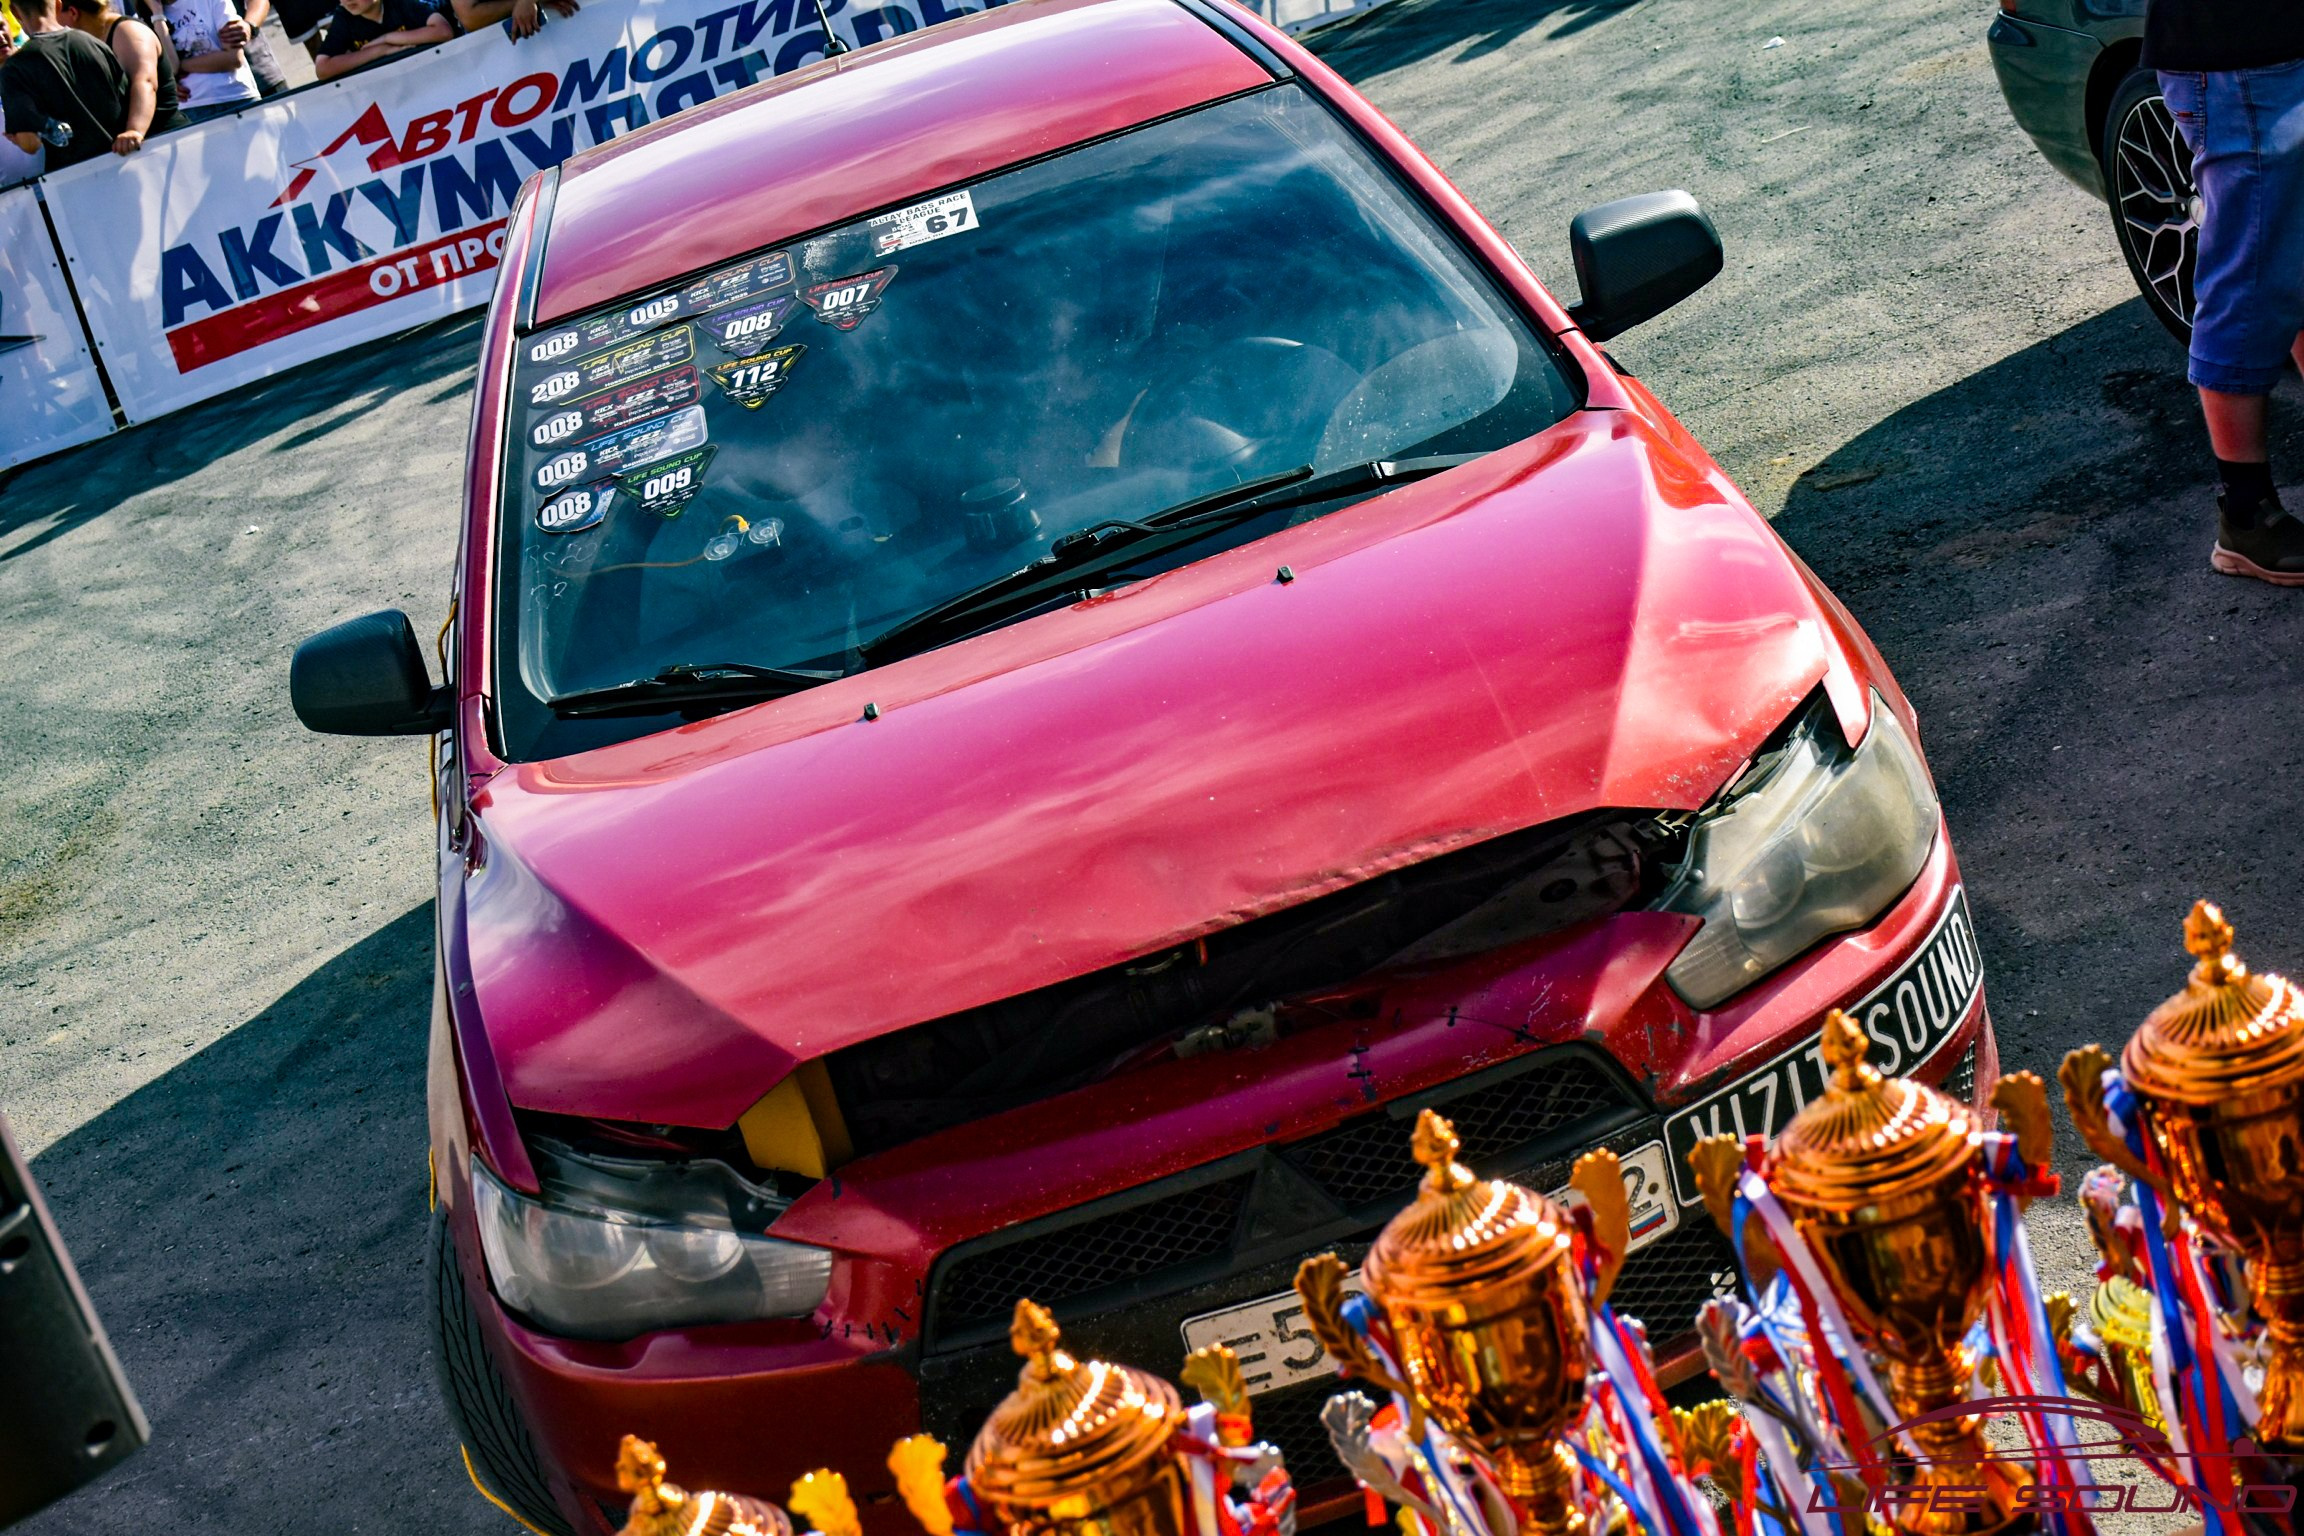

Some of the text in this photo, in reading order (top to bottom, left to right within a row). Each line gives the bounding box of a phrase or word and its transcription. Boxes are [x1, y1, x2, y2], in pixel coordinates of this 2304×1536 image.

[899, 206, 941, 224] LEAGUE
[906, 202, 935, 216] BASS
[938, 192, 967, 206] RACE
[925, 206, 968, 234] 67
[369, 256, 419, 297] ОТ
[864, 270, 885, 280] CUP
[630, 295, 680, 326] 005
[822, 283, 870, 311] 007
[724, 311, 773, 340] 008
[531, 331, 579, 363] 008
[582, 356, 610, 371] LIFE
[613, 340, 656, 359] SOUND
[659, 327, 688, 343] CUP
[717, 361, 738, 372] LIFE
[740, 353, 772, 365] SOUND
[773, 347, 793, 357] CUP
[531, 370, 580, 404] 208
[731, 361, 778, 388] 112
[533, 411, 583, 445] 008
[590, 437, 618, 452] LIFE
[621, 420, 666, 439] SOUND
[669, 409, 699, 424] CUP
[537, 451, 588, 487] 008
[627, 471, 648, 484] LIFE
[649, 459, 682, 477] SOUND
[683, 451, 703, 464] CUP
[643, 467, 692, 500] 009
[541, 492, 592, 527] 008
[1865, 911, 1976, 1076] SOUND
